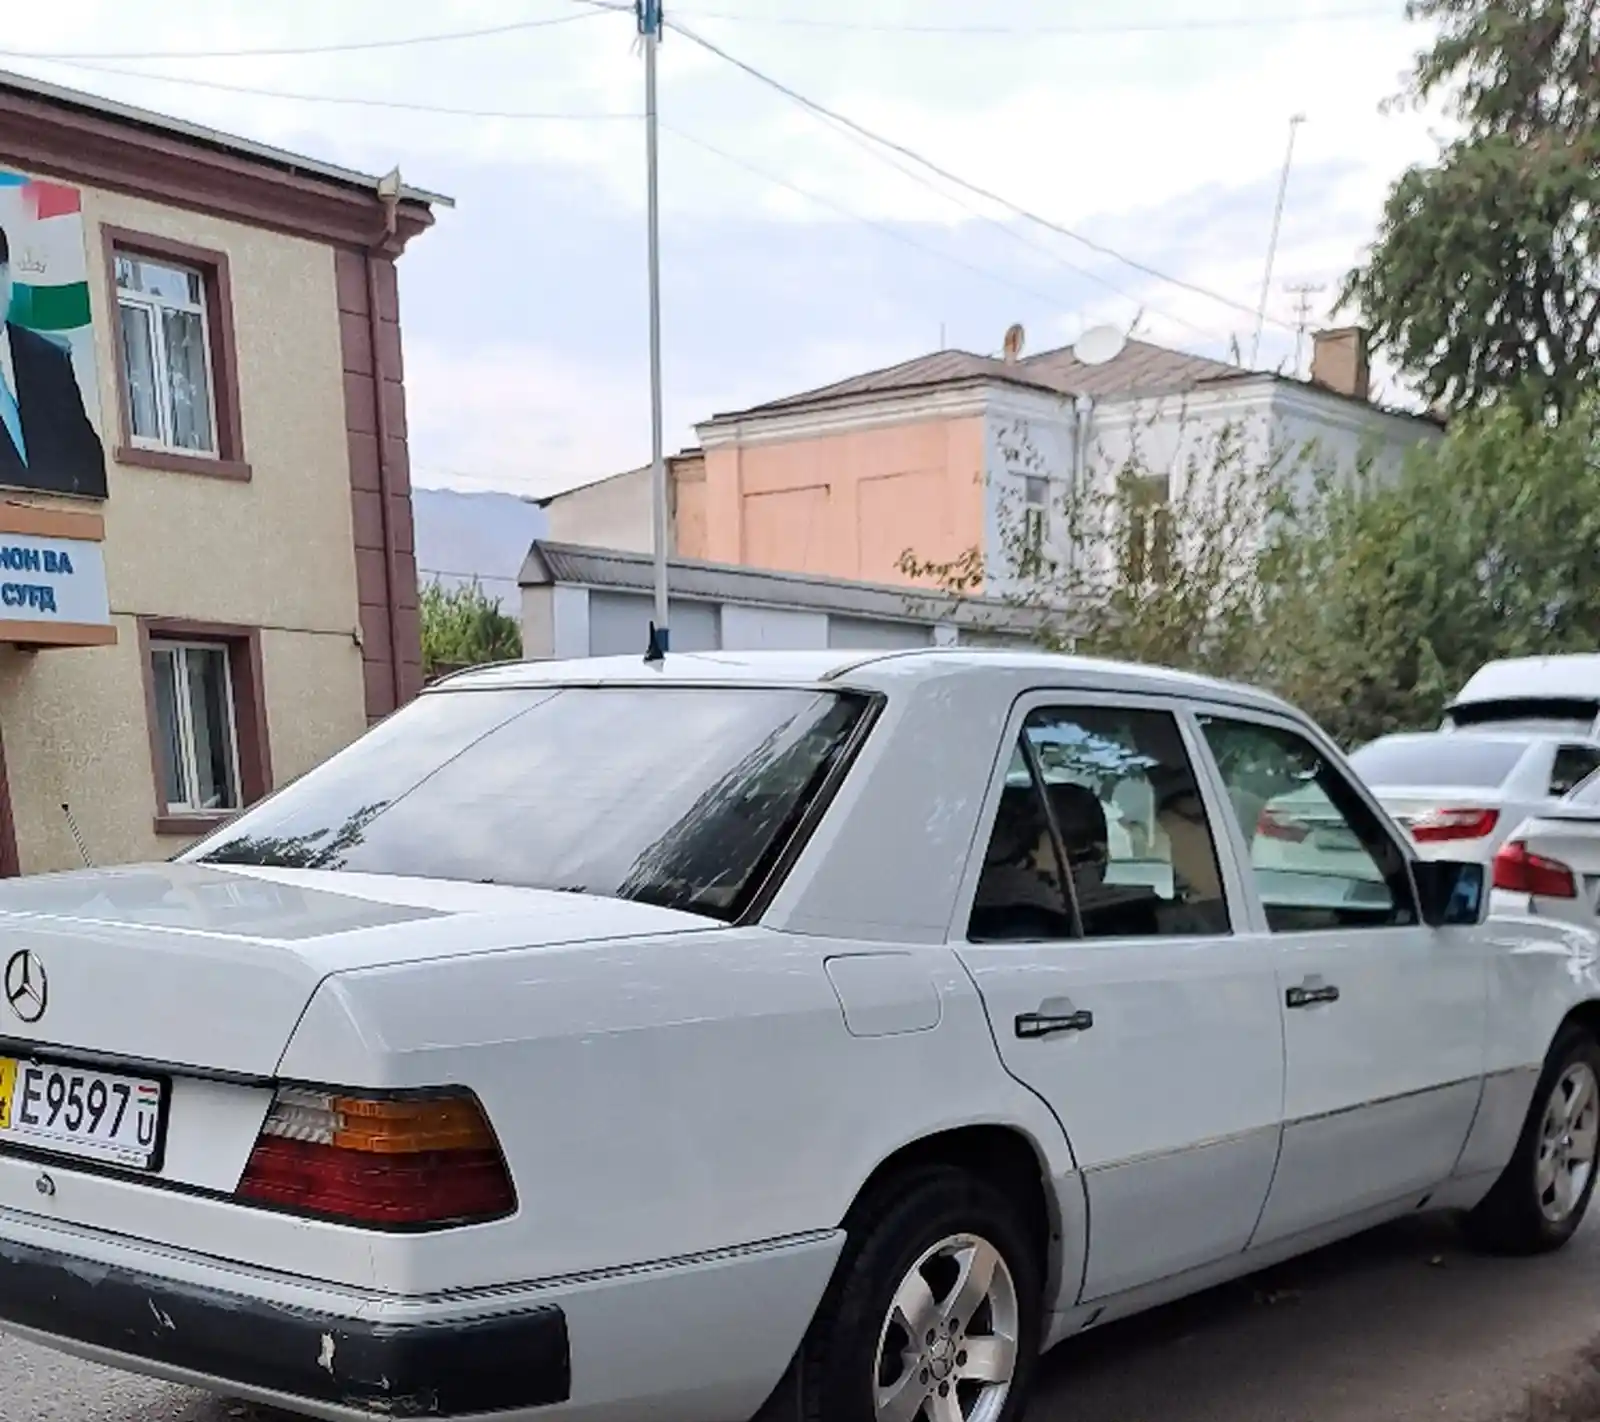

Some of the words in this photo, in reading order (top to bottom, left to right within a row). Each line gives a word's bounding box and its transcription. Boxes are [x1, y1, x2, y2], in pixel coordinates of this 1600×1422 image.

[43, 550, 73, 574] ВА
[20, 1068, 131, 1138] E9597
[137, 1110, 154, 1146] U
